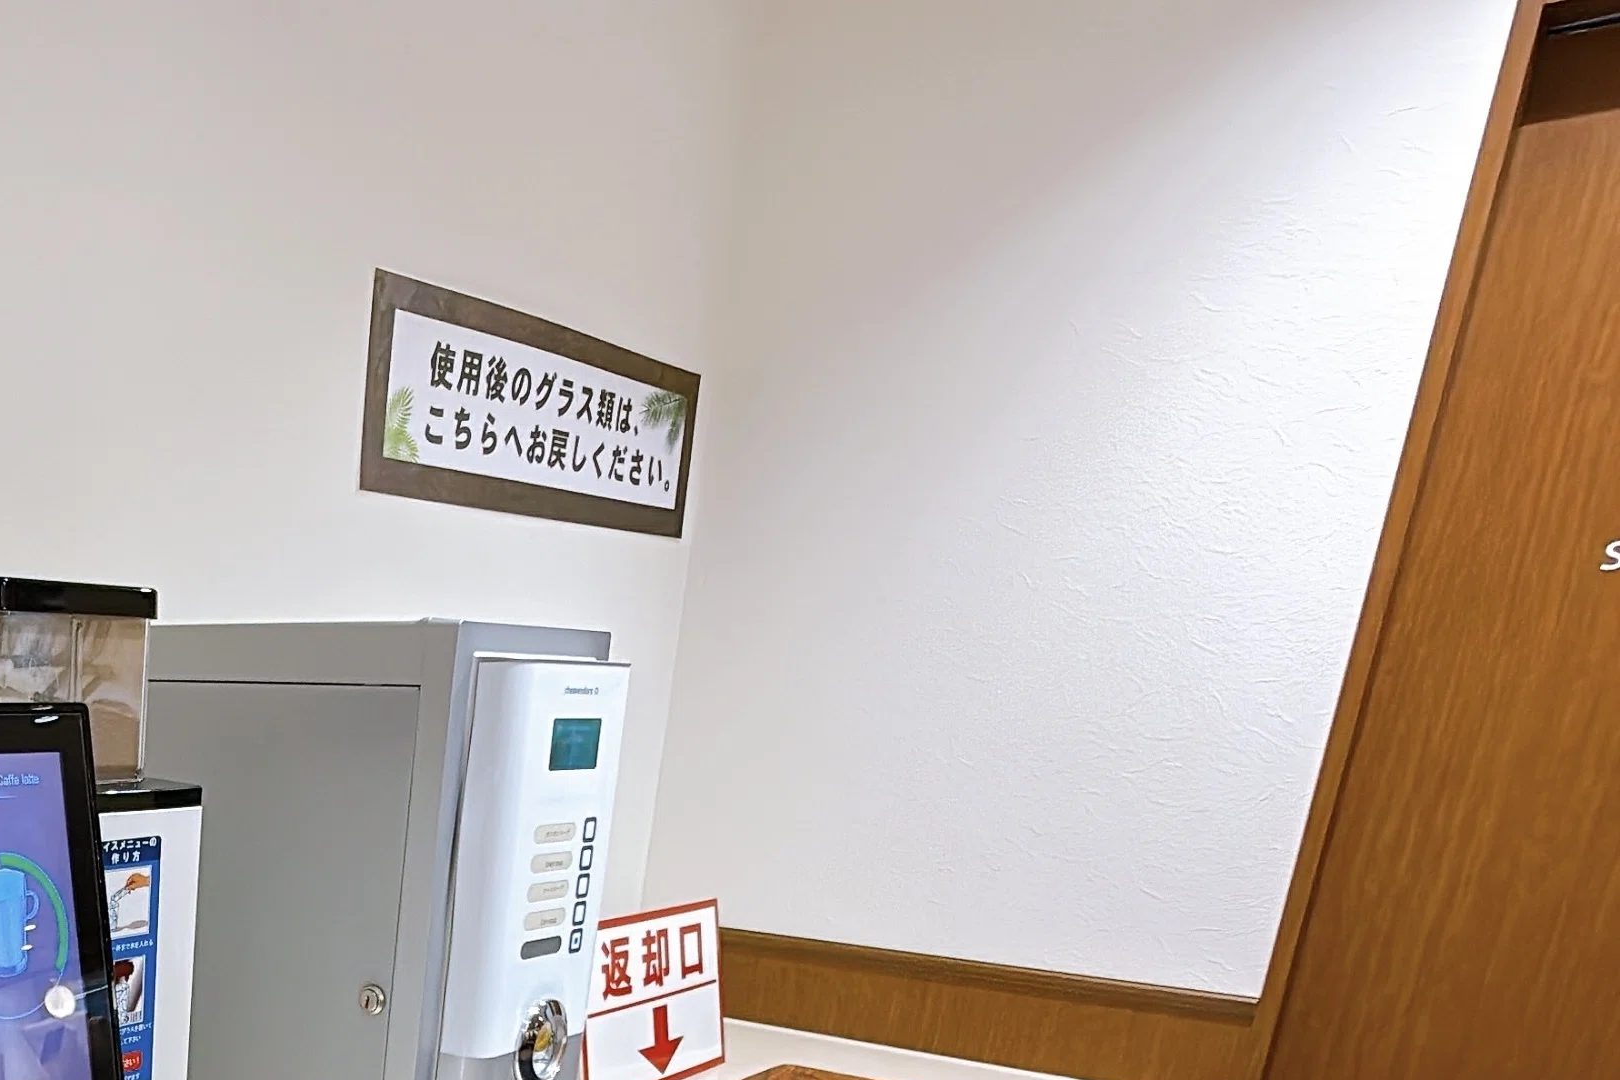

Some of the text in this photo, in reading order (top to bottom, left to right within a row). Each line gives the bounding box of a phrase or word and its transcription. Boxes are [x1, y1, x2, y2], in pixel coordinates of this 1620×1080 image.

[430, 341, 639, 436] 使用後のグラス類は、
[424, 405, 670, 492] こちらへお戻しください。
[103, 837, 157, 852] イスメニューの
[111, 850, 141, 865] 作り方
[601, 922, 704, 1002] 返却口
